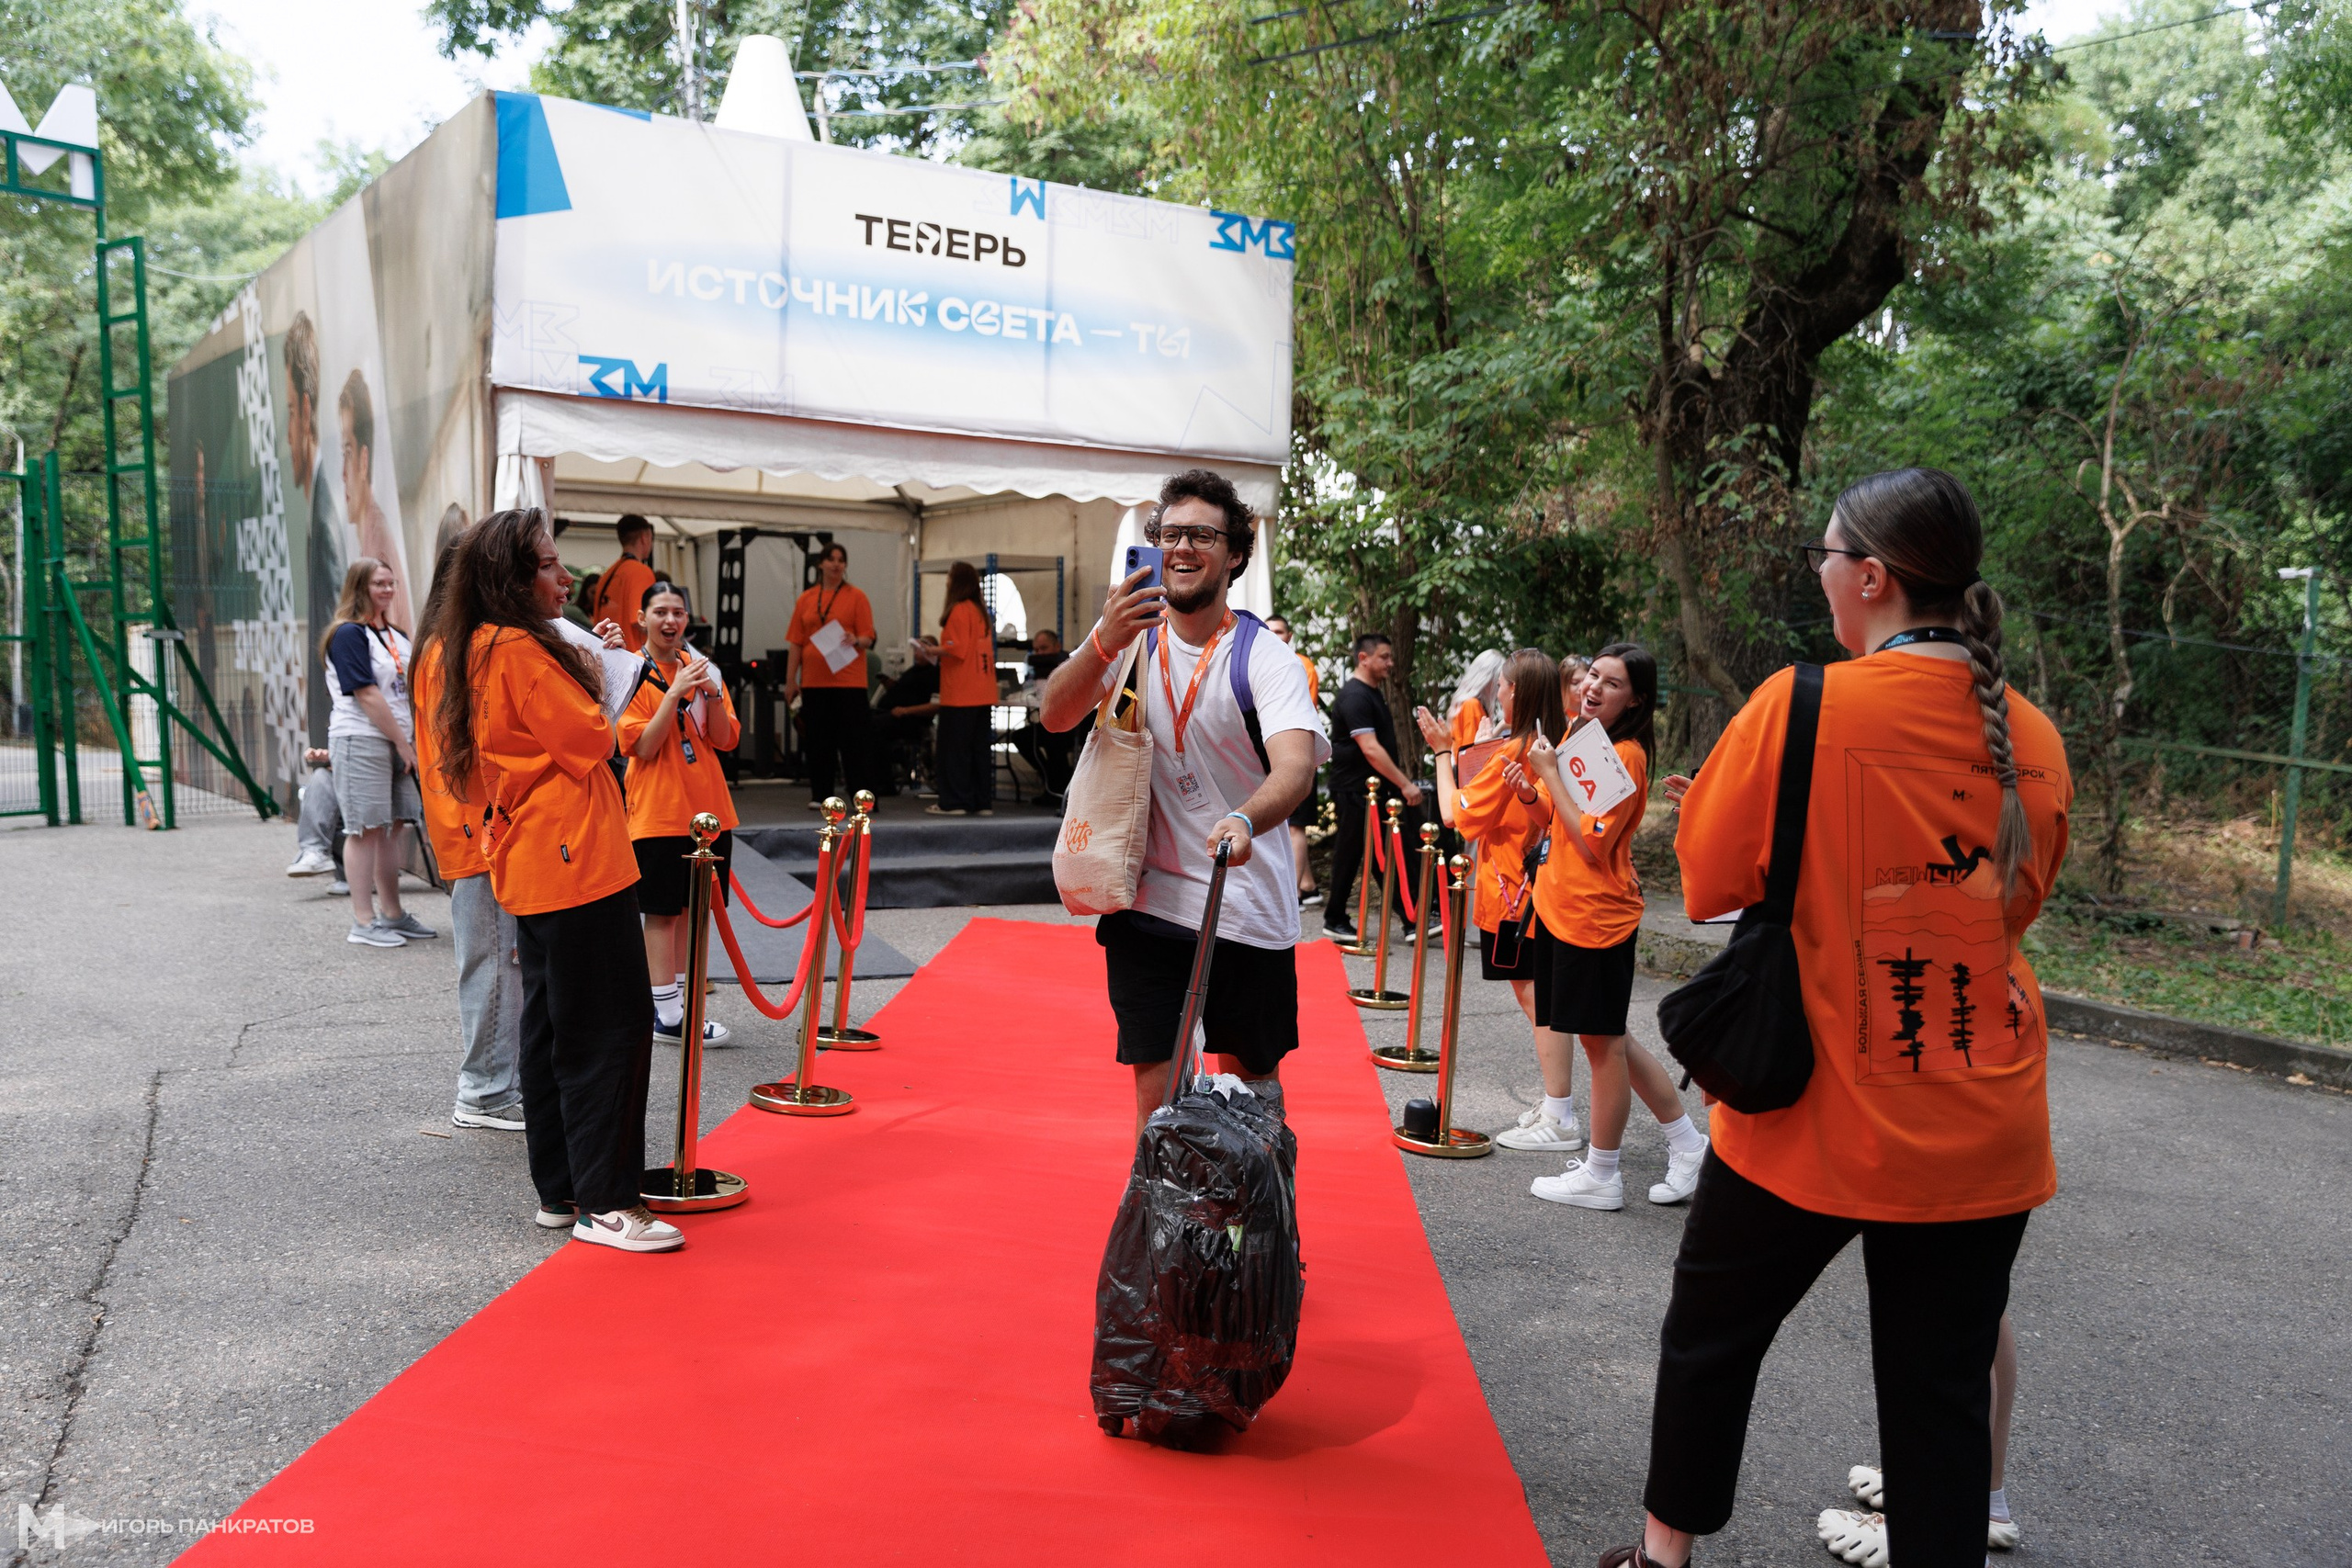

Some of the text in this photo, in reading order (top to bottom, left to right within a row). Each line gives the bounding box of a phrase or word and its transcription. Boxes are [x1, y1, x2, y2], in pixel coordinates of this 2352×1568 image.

[854, 213, 1026, 267] ТЕПЕРЬ
[647, 258, 929, 327] ИСТОЧНИК
[937, 296, 1082, 347] СВЕТА
[1130, 321, 1192, 359] ТЫ
[1971, 764, 2045, 780] ПЯТОРСК
